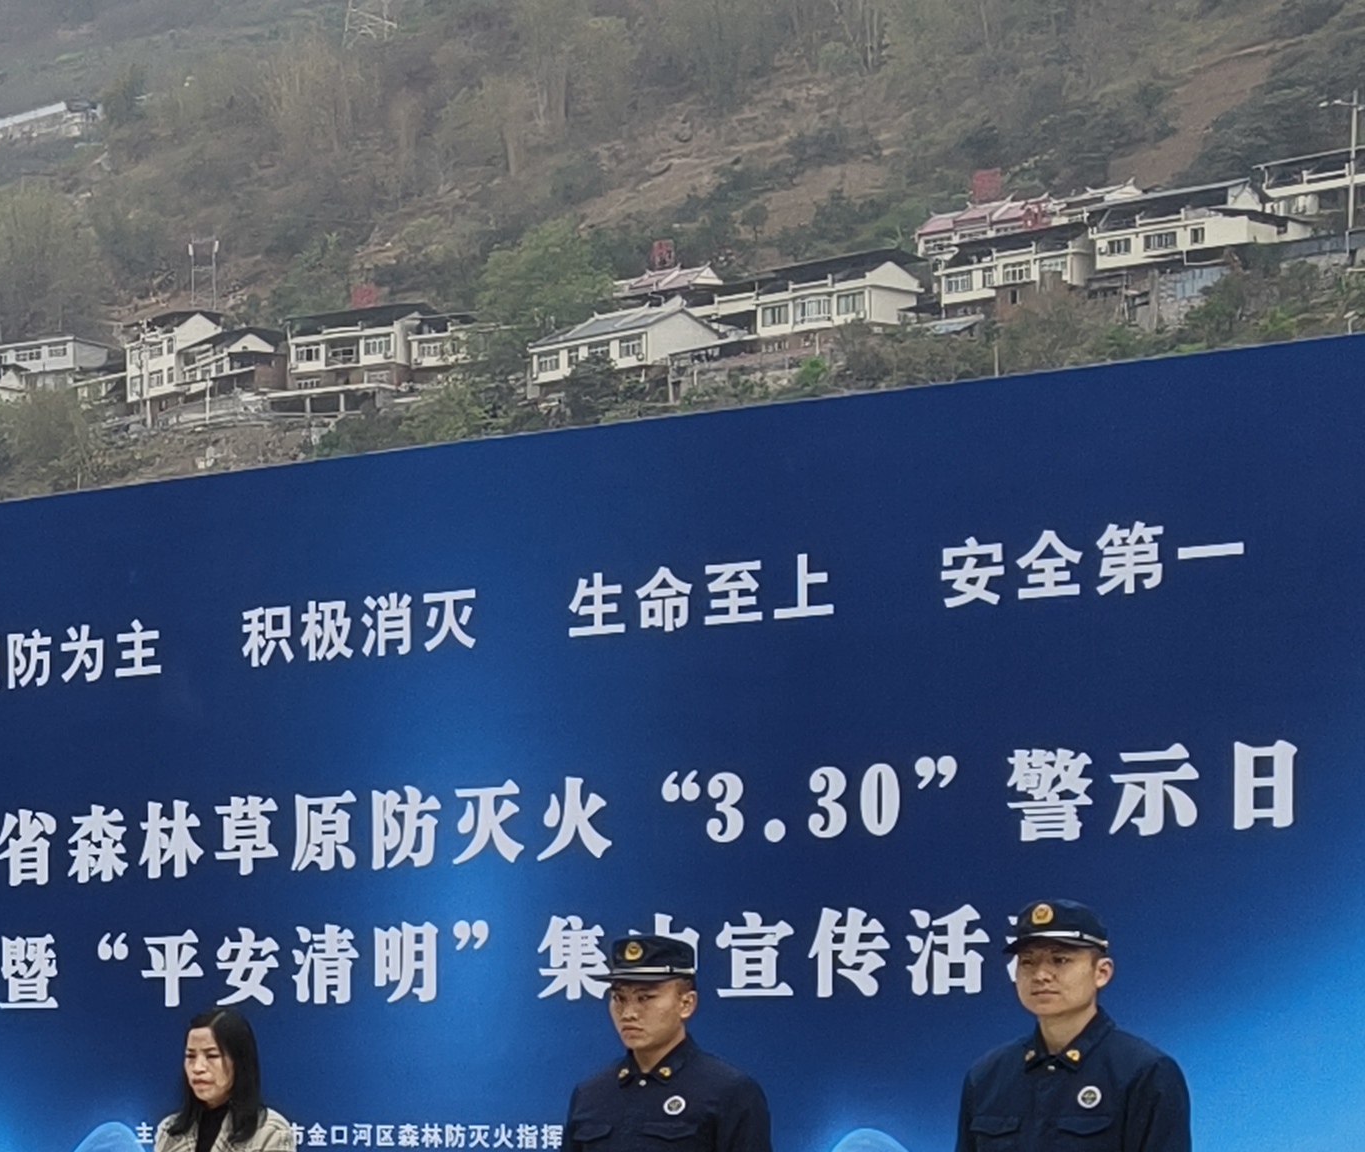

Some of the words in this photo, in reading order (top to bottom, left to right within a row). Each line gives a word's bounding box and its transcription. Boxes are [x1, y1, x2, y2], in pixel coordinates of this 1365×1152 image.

[242, 588, 477, 667] 积极消灭
[568, 553, 835, 638] 生命至上
[940, 520, 1245, 608] 安全第一
